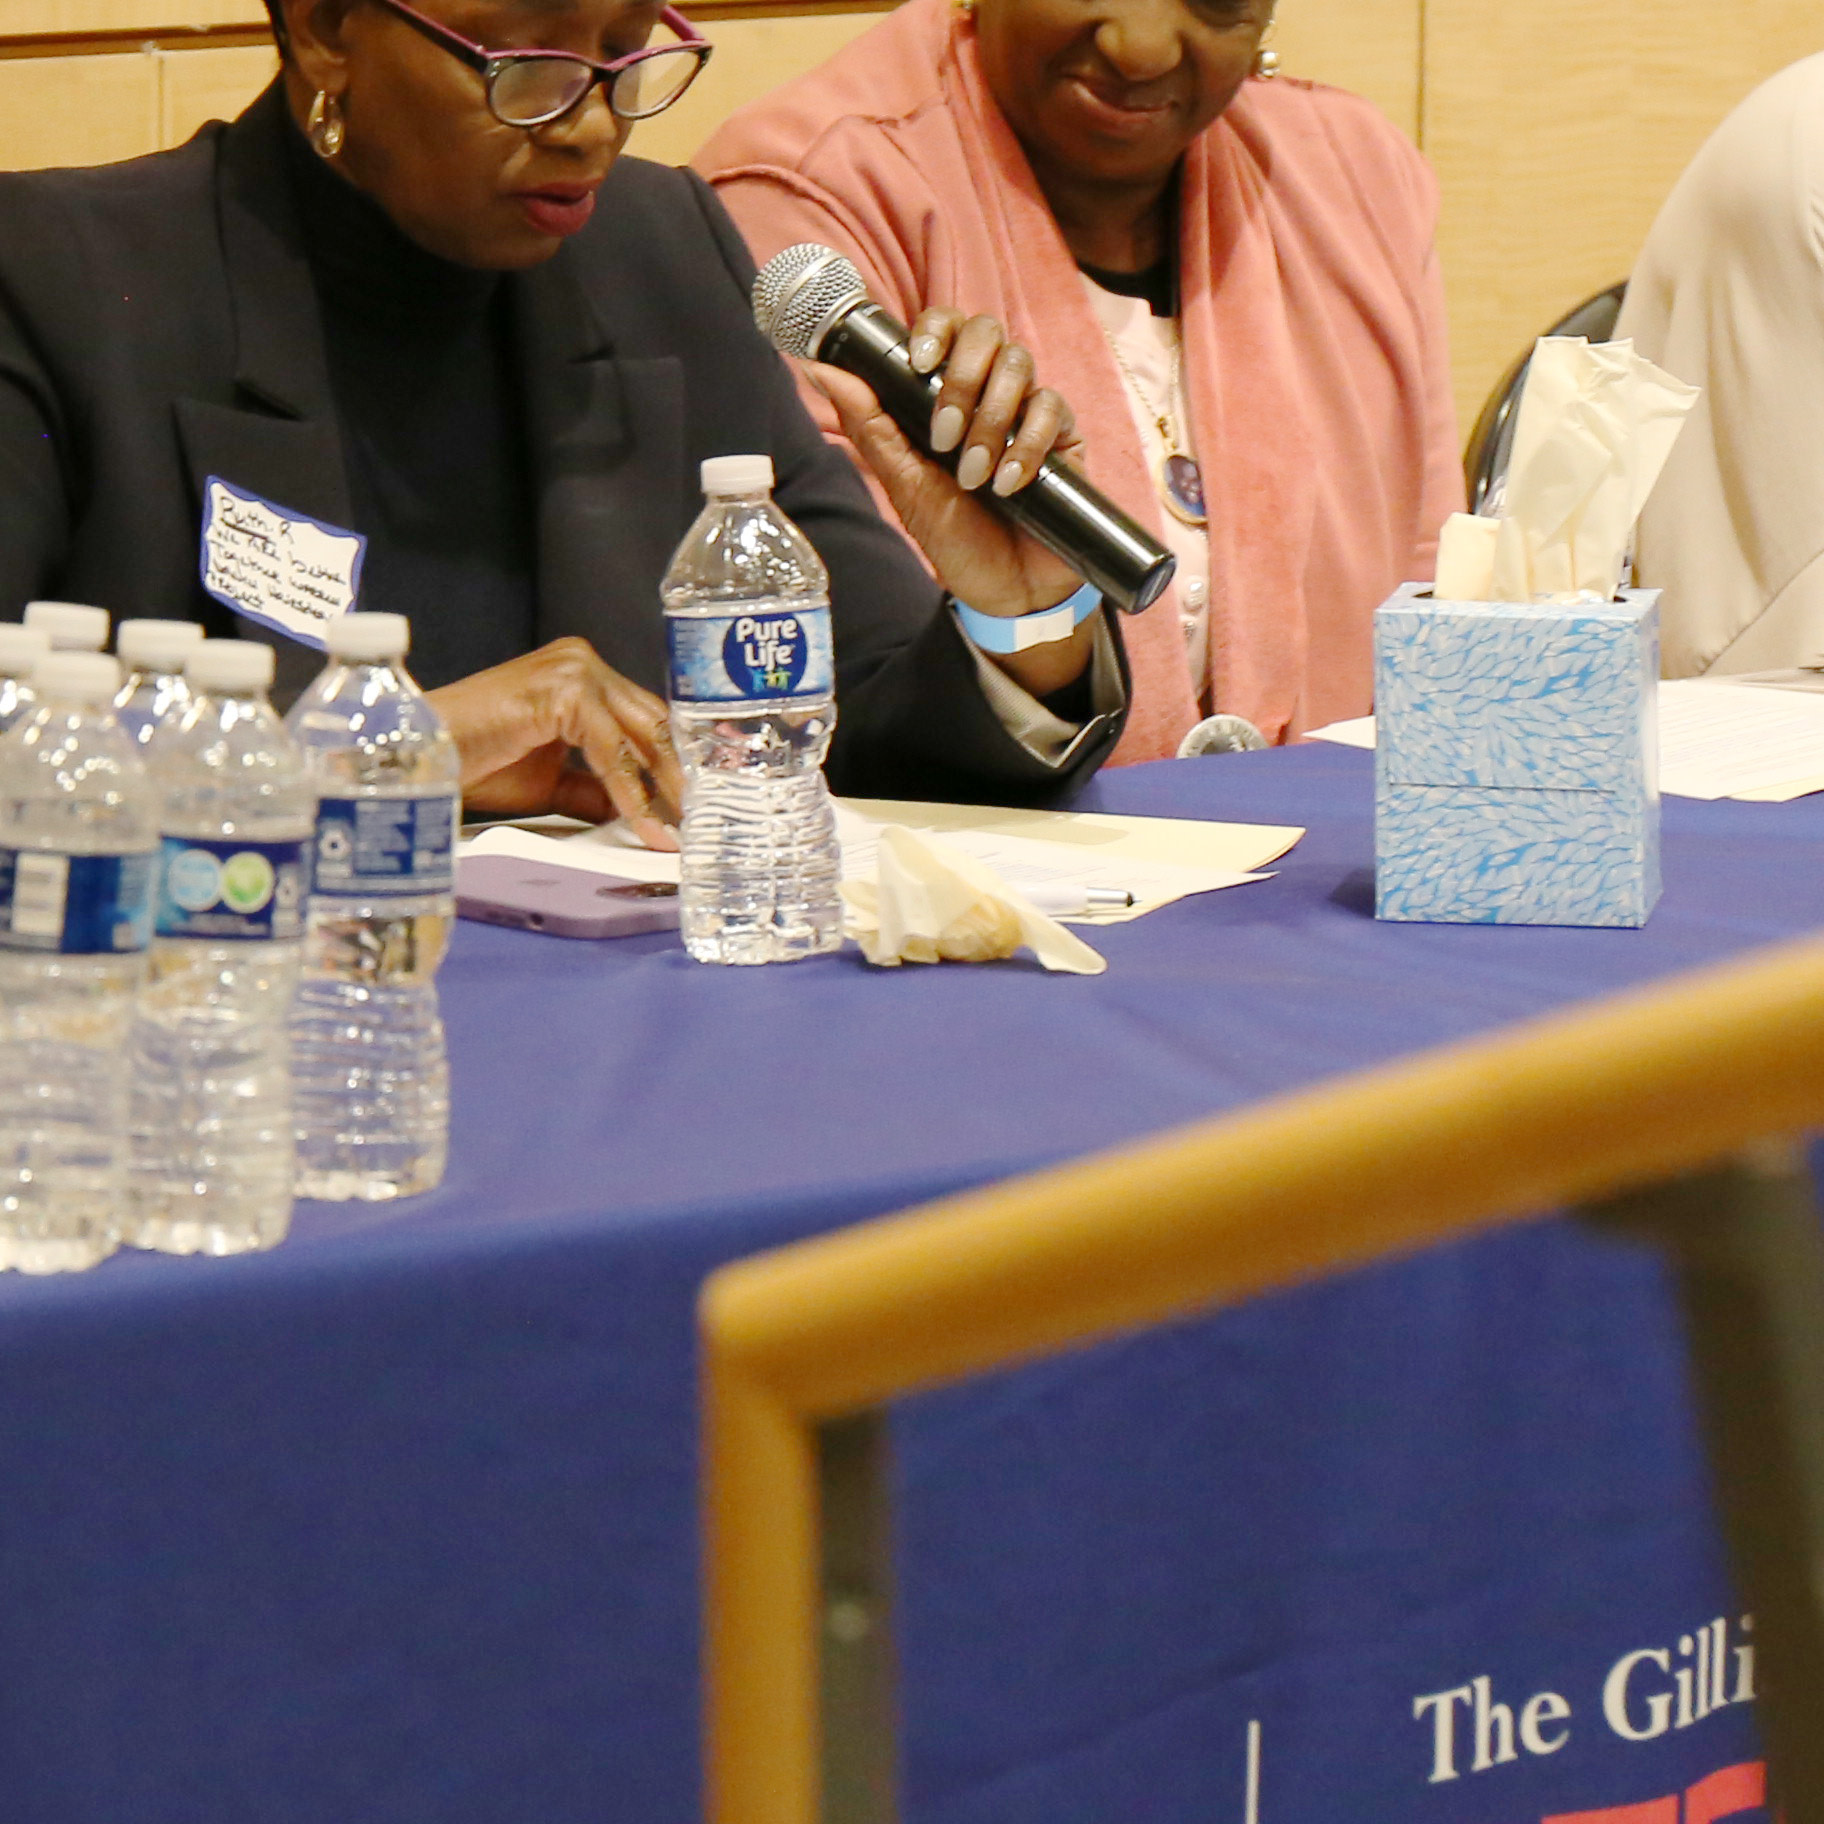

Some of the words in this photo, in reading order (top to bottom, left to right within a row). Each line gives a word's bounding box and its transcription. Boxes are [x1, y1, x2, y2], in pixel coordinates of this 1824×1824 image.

[736, 617, 798, 643] Pure
[744, 640, 793, 672] Life
[1412, 1675, 1572, 1784] The
